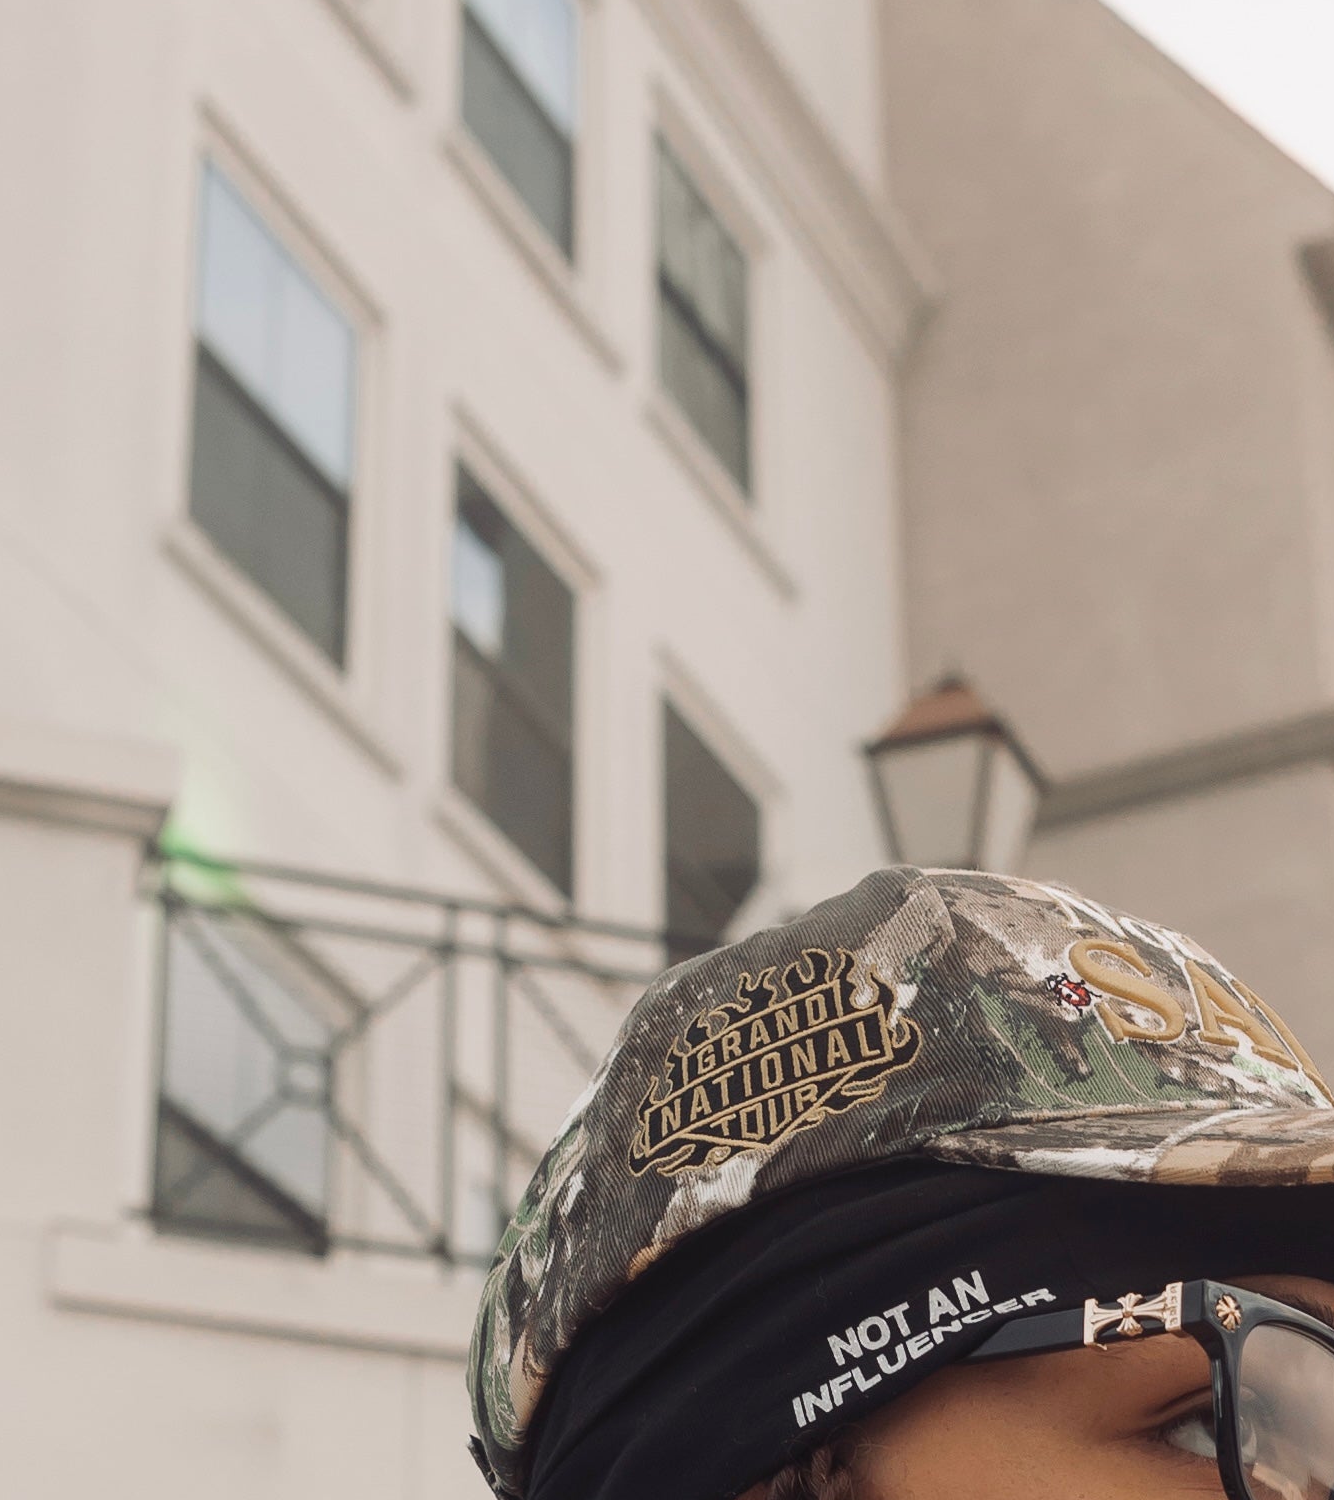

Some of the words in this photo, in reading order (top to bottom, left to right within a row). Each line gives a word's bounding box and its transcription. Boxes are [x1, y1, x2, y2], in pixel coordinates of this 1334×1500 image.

[660, 1021, 881, 1138] NATIONAL
[697, 993, 827, 1074] GRAND
[709, 1083, 820, 1141] TOUR
[792, 1287, 1057, 1428] INFLUENCER
[827, 1301, 910, 1366] NOT
[927, 1269, 990, 1325] AN
